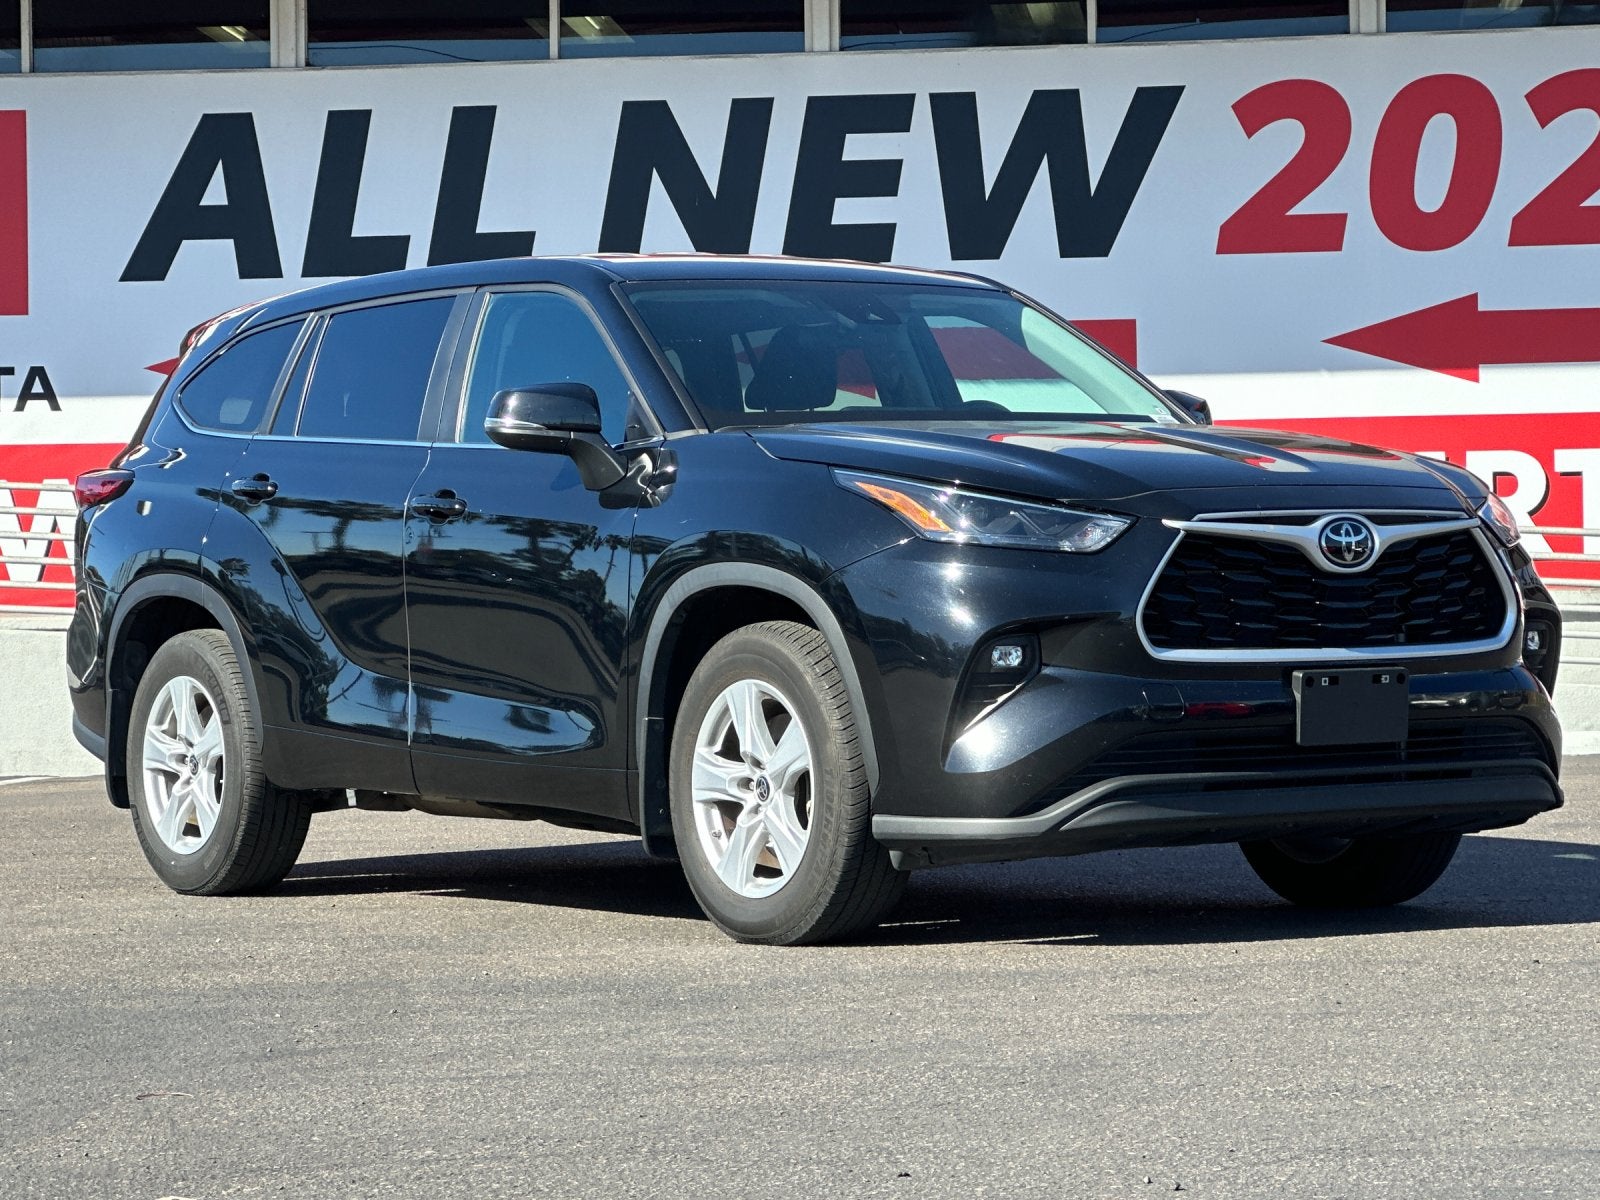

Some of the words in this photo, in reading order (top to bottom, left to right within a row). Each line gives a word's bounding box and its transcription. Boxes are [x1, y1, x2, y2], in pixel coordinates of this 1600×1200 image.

[119, 105, 536, 282] ALL
[598, 85, 1187, 263] NEW
[1216, 68, 1600, 256] 202
[1415, 448, 1600, 556] RT
